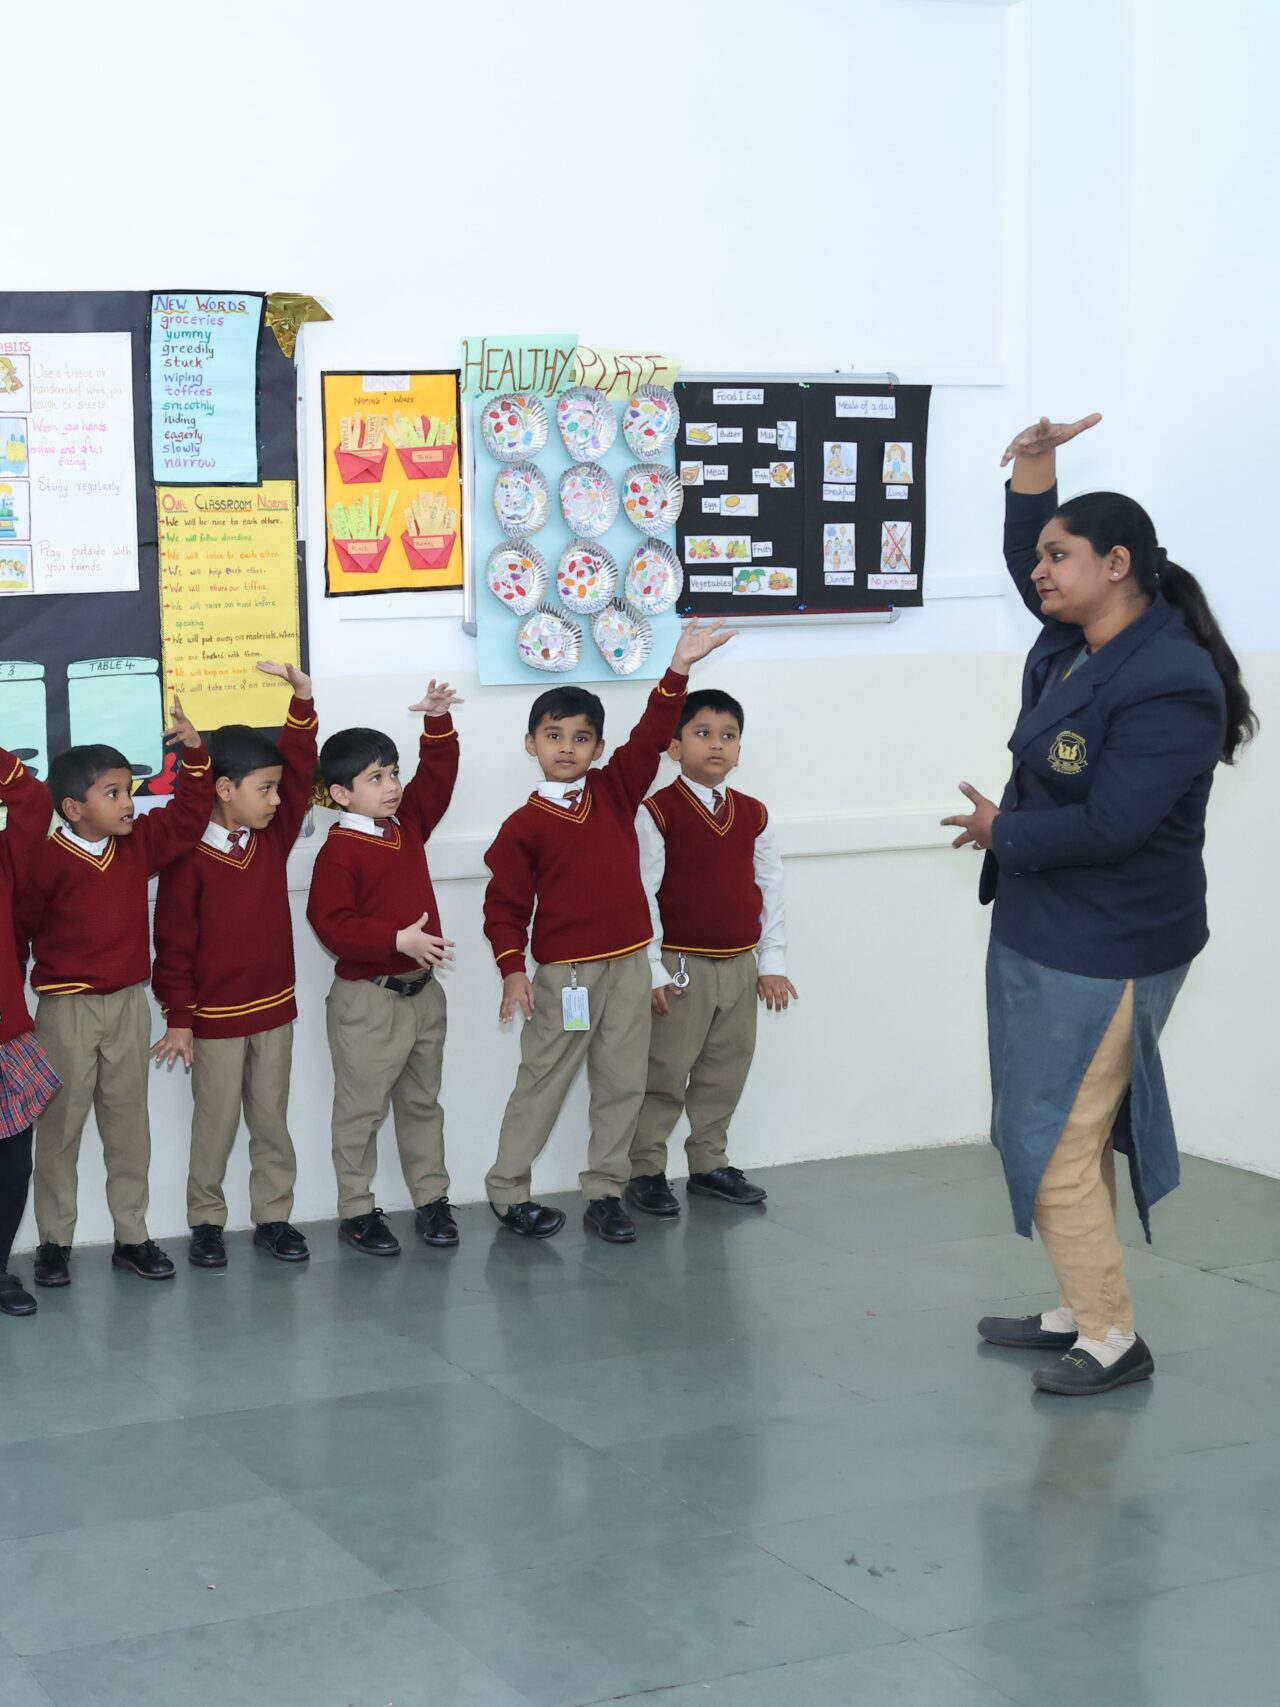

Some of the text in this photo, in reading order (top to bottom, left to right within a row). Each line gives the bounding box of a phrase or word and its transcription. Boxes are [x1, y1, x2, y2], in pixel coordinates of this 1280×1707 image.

[153, 295, 247, 312] NEW WORDS
[160, 314, 224, 330] groceries
[163, 330, 212, 344] yummy
[161, 343, 214, 360] greedily
[163, 356, 203, 369] stuck
[461, 338, 576, 398] HEALTHY
[163, 372, 203, 388] wiping
[165, 385, 213, 397] toffees
[716, 390, 762, 402] Food I Eat
[161, 400, 215, 416] smoothly
[861, 400, 869, 415] of
[880, 400, 895, 417] day
[82, 418, 109, 432] hands
[164, 412, 196, 430] hiding
[164, 429, 203, 445] eagerly
[719, 429, 741, 439] Butter
[760, 430, 775, 440] Milk
[162, 442, 200, 458] slowly
[163, 458, 216, 469] narrow
[706, 467, 726, 477] Meat
[754, 470, 769, 480] Fish
[37, 476, 120, 498] Study regularly
[887, 487, 908, 497] Lunch
[704, 499, 718, 510] Eggs
[165, 516, 179, 527] We
[184, 518, 196, 527] will
[212, 518, 226, 526] nice
[230, 517, 238, 525] to
[166, 532, 179, 543] We
[753, 543, 772, 555] Fruits
[690, 575, 732, 589] Vegetables
[871, 577, 881, 585] No
[172, 632, 184, 645] We
[187, 633, 199, 643] will
[7, 664, 16, 676] 3
[89, 660, 136, 672] TABLE 4
[175, 682, 186, 693] We
[190, 683, 202, 693] will
